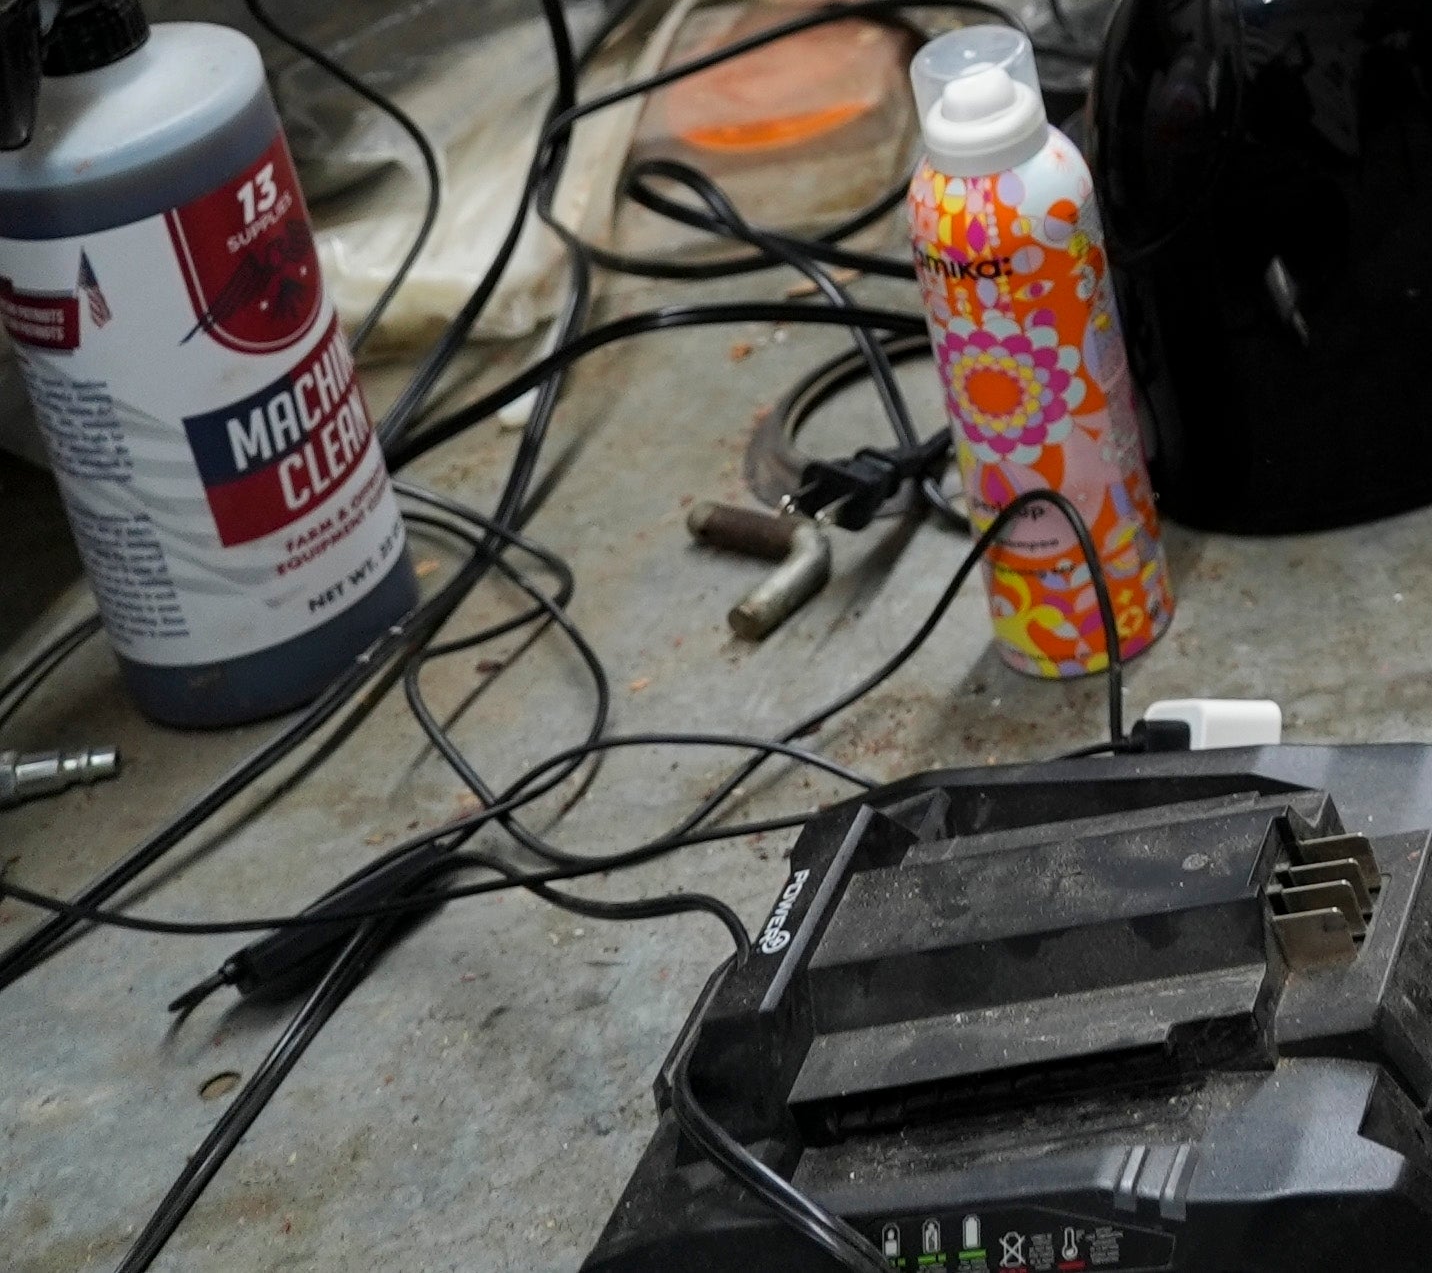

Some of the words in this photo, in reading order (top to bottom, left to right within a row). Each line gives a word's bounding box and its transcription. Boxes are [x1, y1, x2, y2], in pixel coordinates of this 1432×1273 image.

[236, 162, 278, 225] 13
[226, 190, 293, 254] SUPPLIES
[285, 518, 334, 553] FARM
[308, 581, 345, 613] NET
